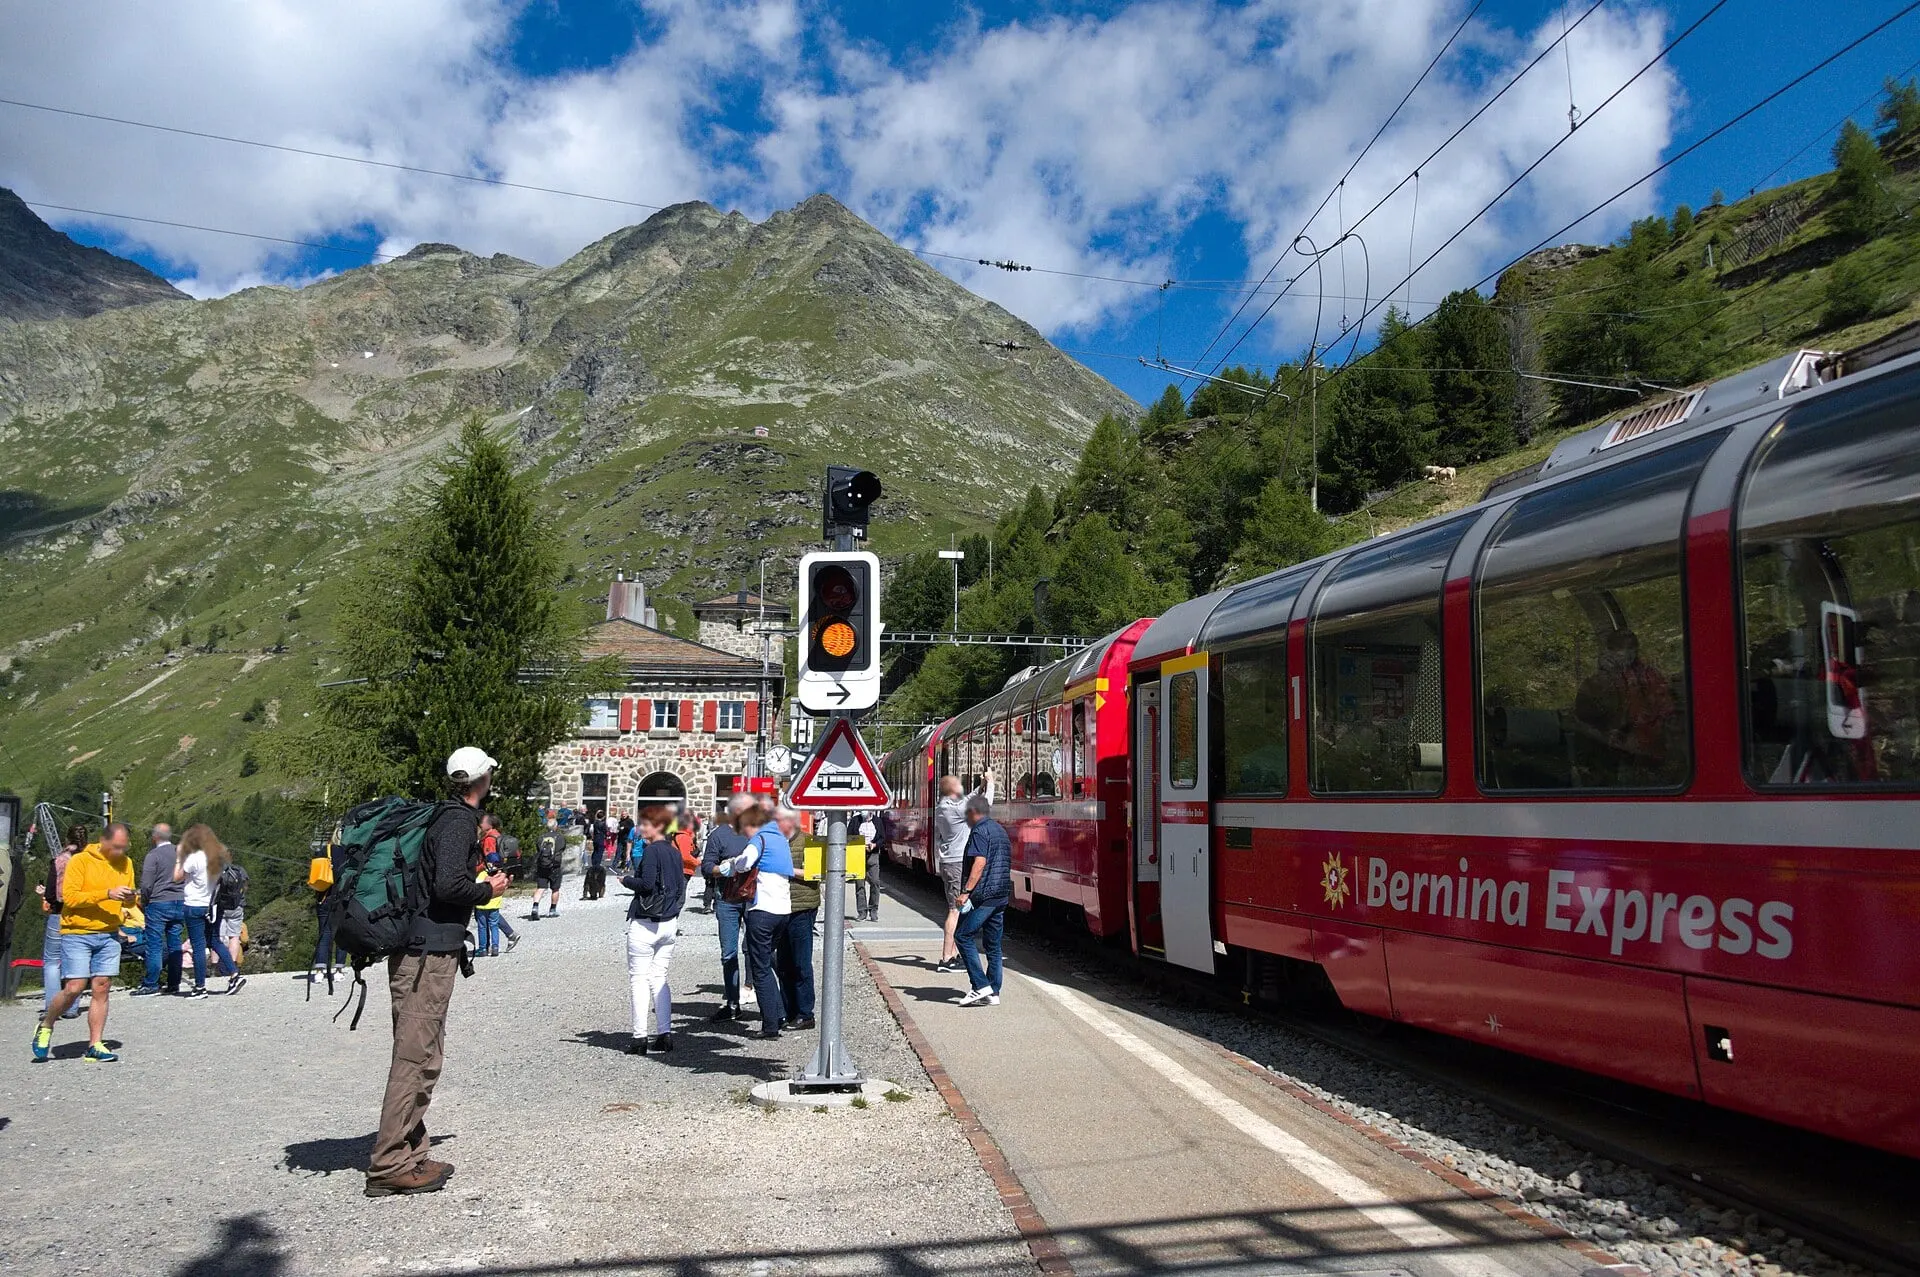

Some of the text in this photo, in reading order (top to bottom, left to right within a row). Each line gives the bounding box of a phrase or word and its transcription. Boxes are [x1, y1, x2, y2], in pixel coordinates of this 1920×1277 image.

[1292, 676, 1300, 719] 1
[580, 747, 605, 757] ALP
[679, 748, 724, 758] BUFFET
[1366, 857, 1794, 960] Bernina Express
